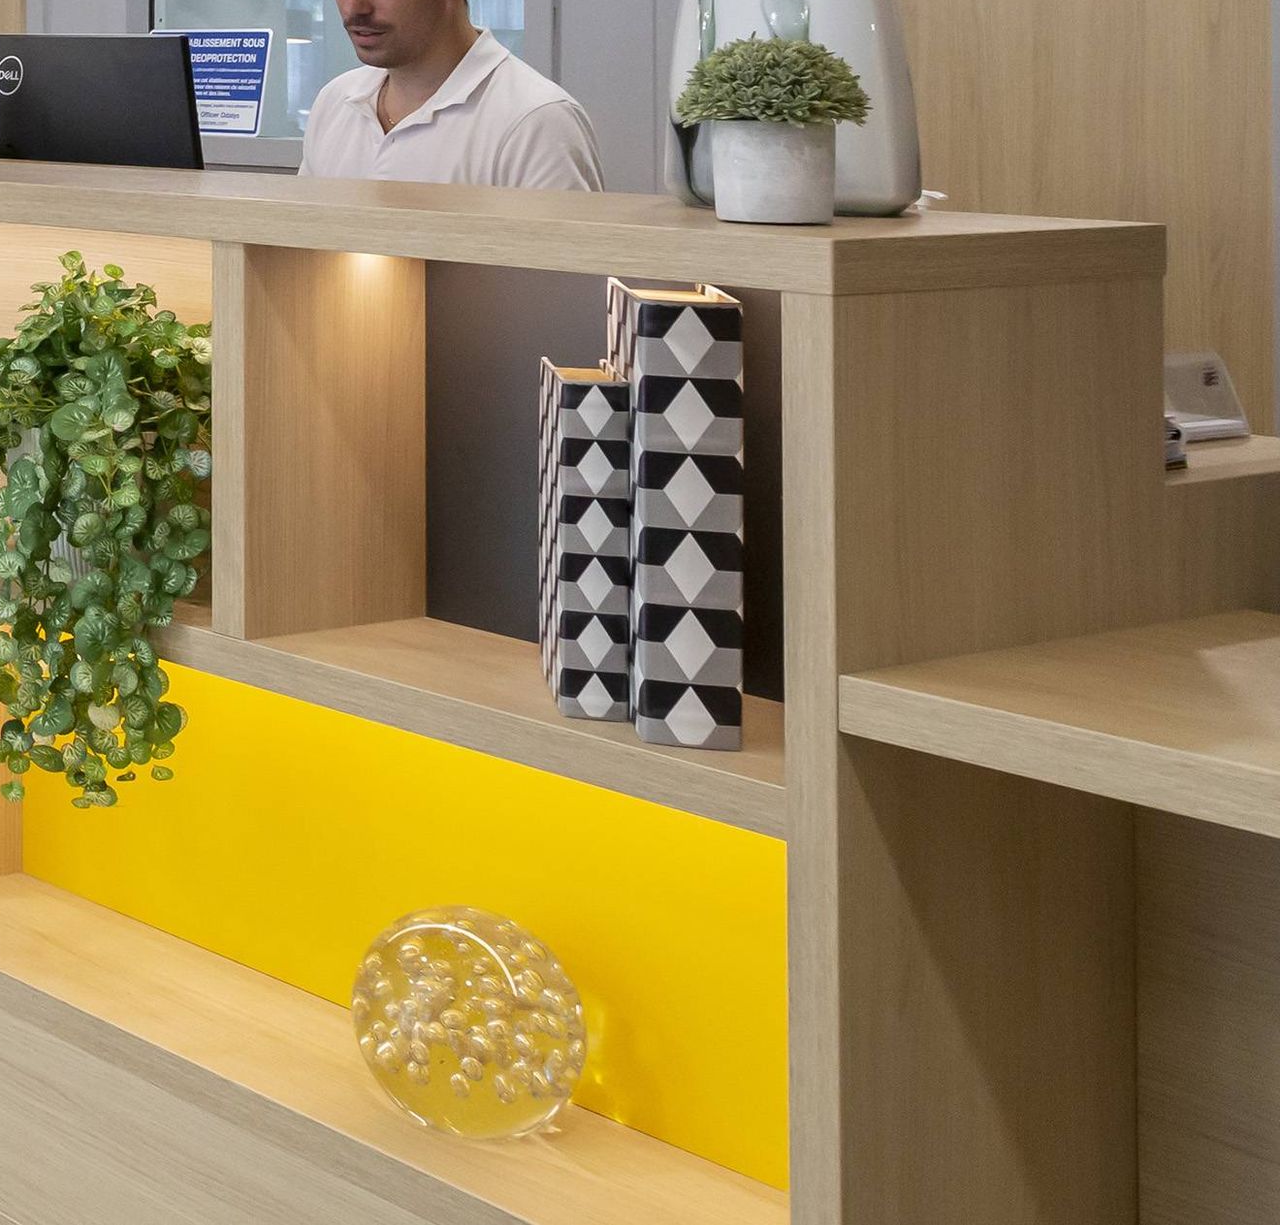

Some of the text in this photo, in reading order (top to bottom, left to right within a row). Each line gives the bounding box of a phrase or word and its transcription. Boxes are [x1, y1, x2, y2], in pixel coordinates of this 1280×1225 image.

[189, 38, 266, 48] ABLISSEMENT SOUS
[191, 53, 257, 64] DEOPROTECTION
